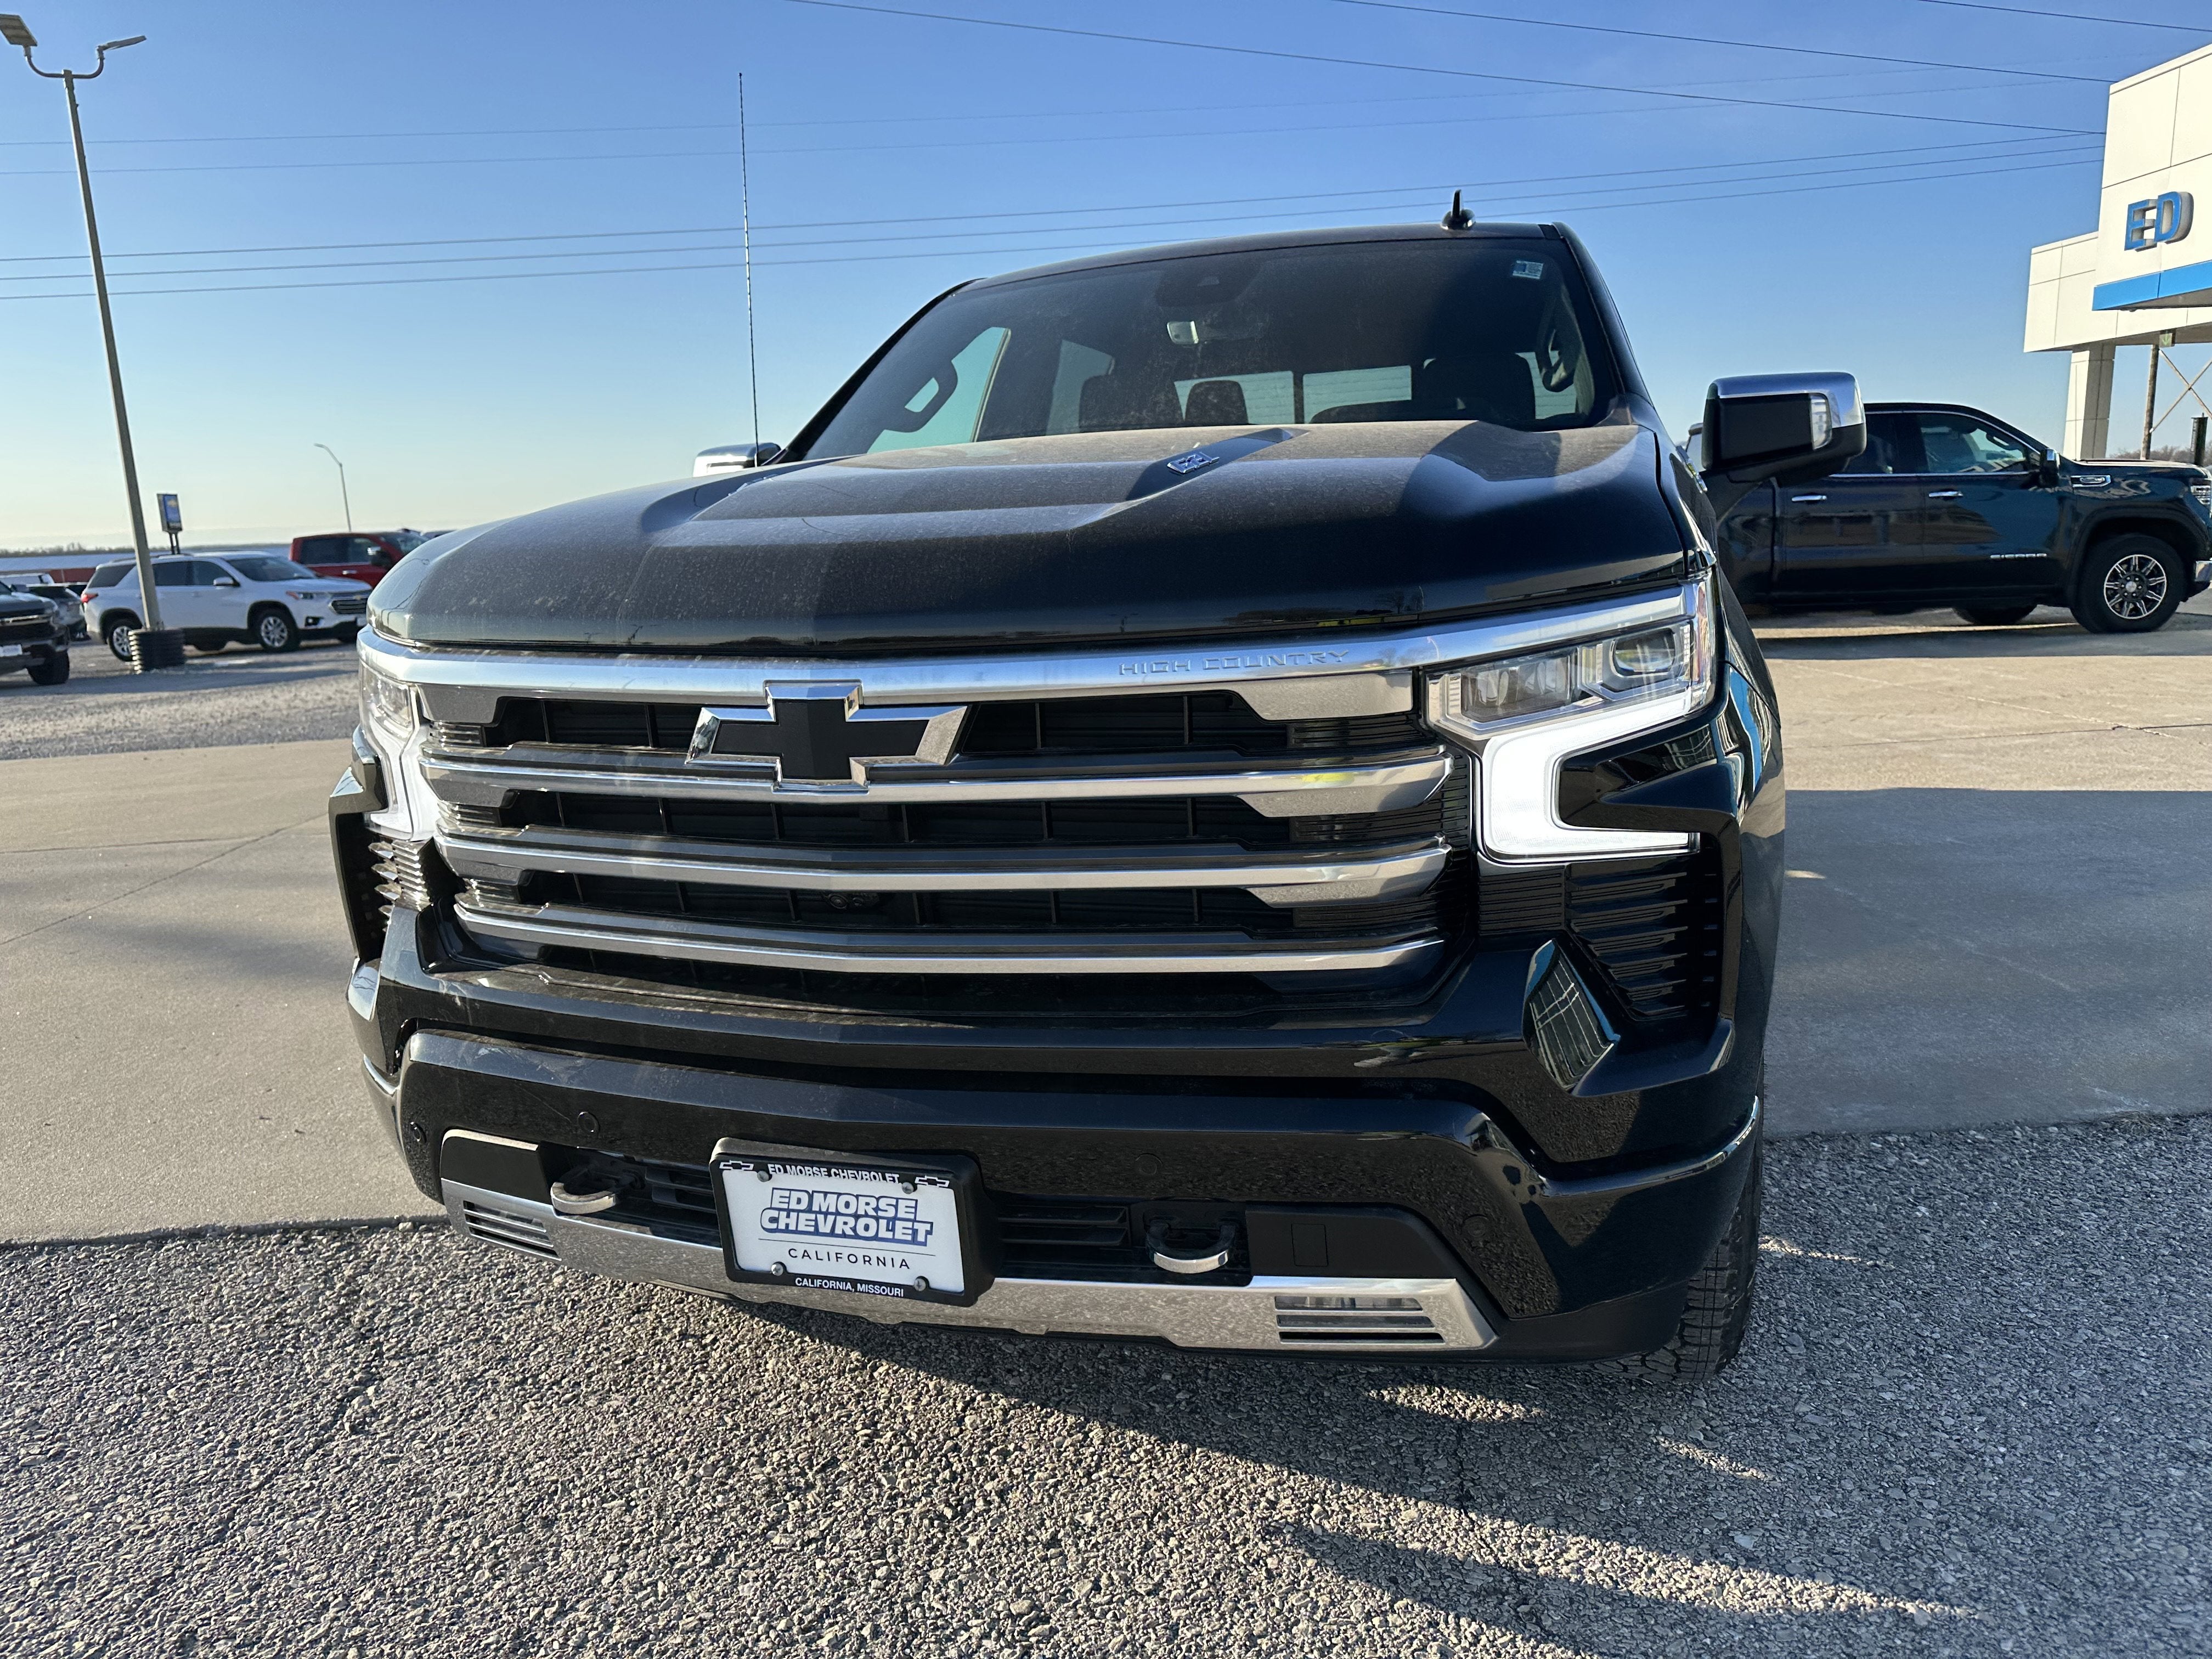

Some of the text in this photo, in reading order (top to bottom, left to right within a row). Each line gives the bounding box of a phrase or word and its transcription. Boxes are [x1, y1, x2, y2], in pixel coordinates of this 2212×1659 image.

[2125, 191, 2194, 252] ED
[1119, 650, 1349, 675] HIGH COUNTRY
[768, 1164, 900, 1183] ED MORSE CHEVROLET
[771, 1188, 918, 1220] ED MORSE
[760, 1207, 933, 1246] CHEVROLET
[788, 1248, 910, 1269] CALIFORNIA
[795, 1277, 904, 1297] CALIFORNIA, MISSOURI
